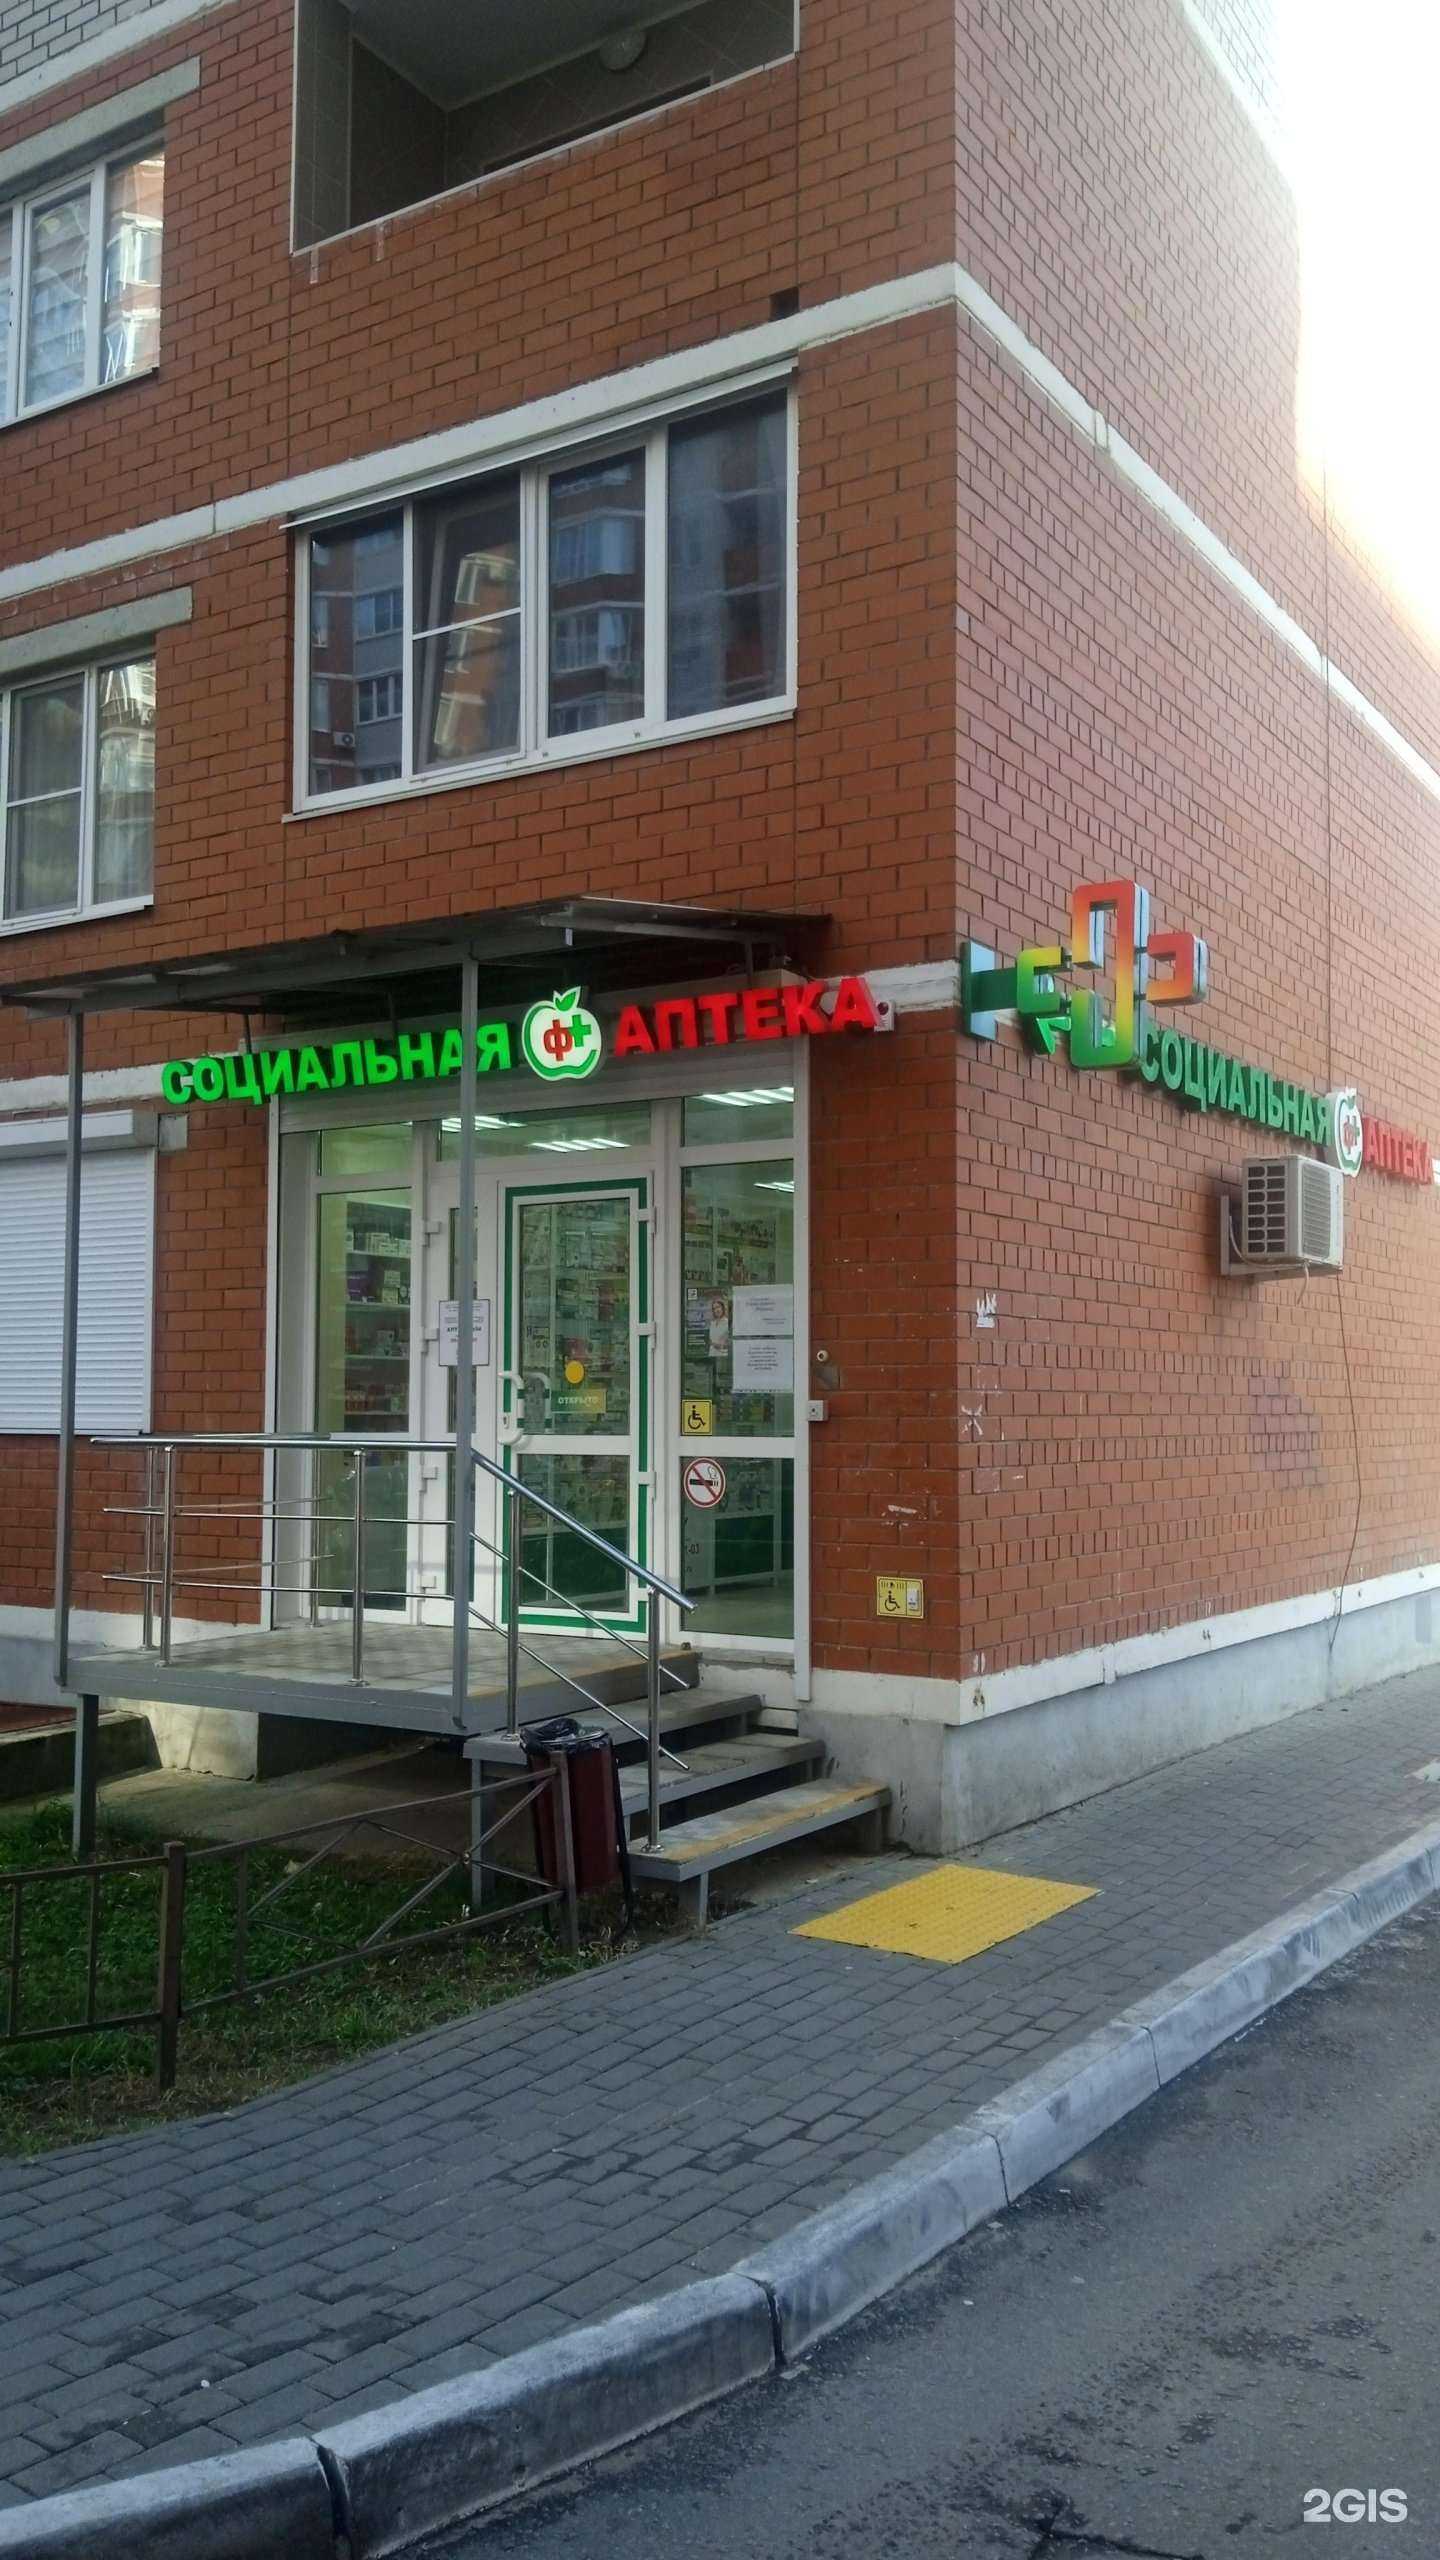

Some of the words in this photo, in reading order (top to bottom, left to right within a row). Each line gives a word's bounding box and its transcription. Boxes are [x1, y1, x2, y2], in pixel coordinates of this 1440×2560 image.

[161, 1023, 511, 1105] СОЦИАЛЬНАЯ
[614, 976, 876, 1057] АПТЕКА
[1140, 1022, 1330, 1146] СОЦИАЛЬНАЯ
